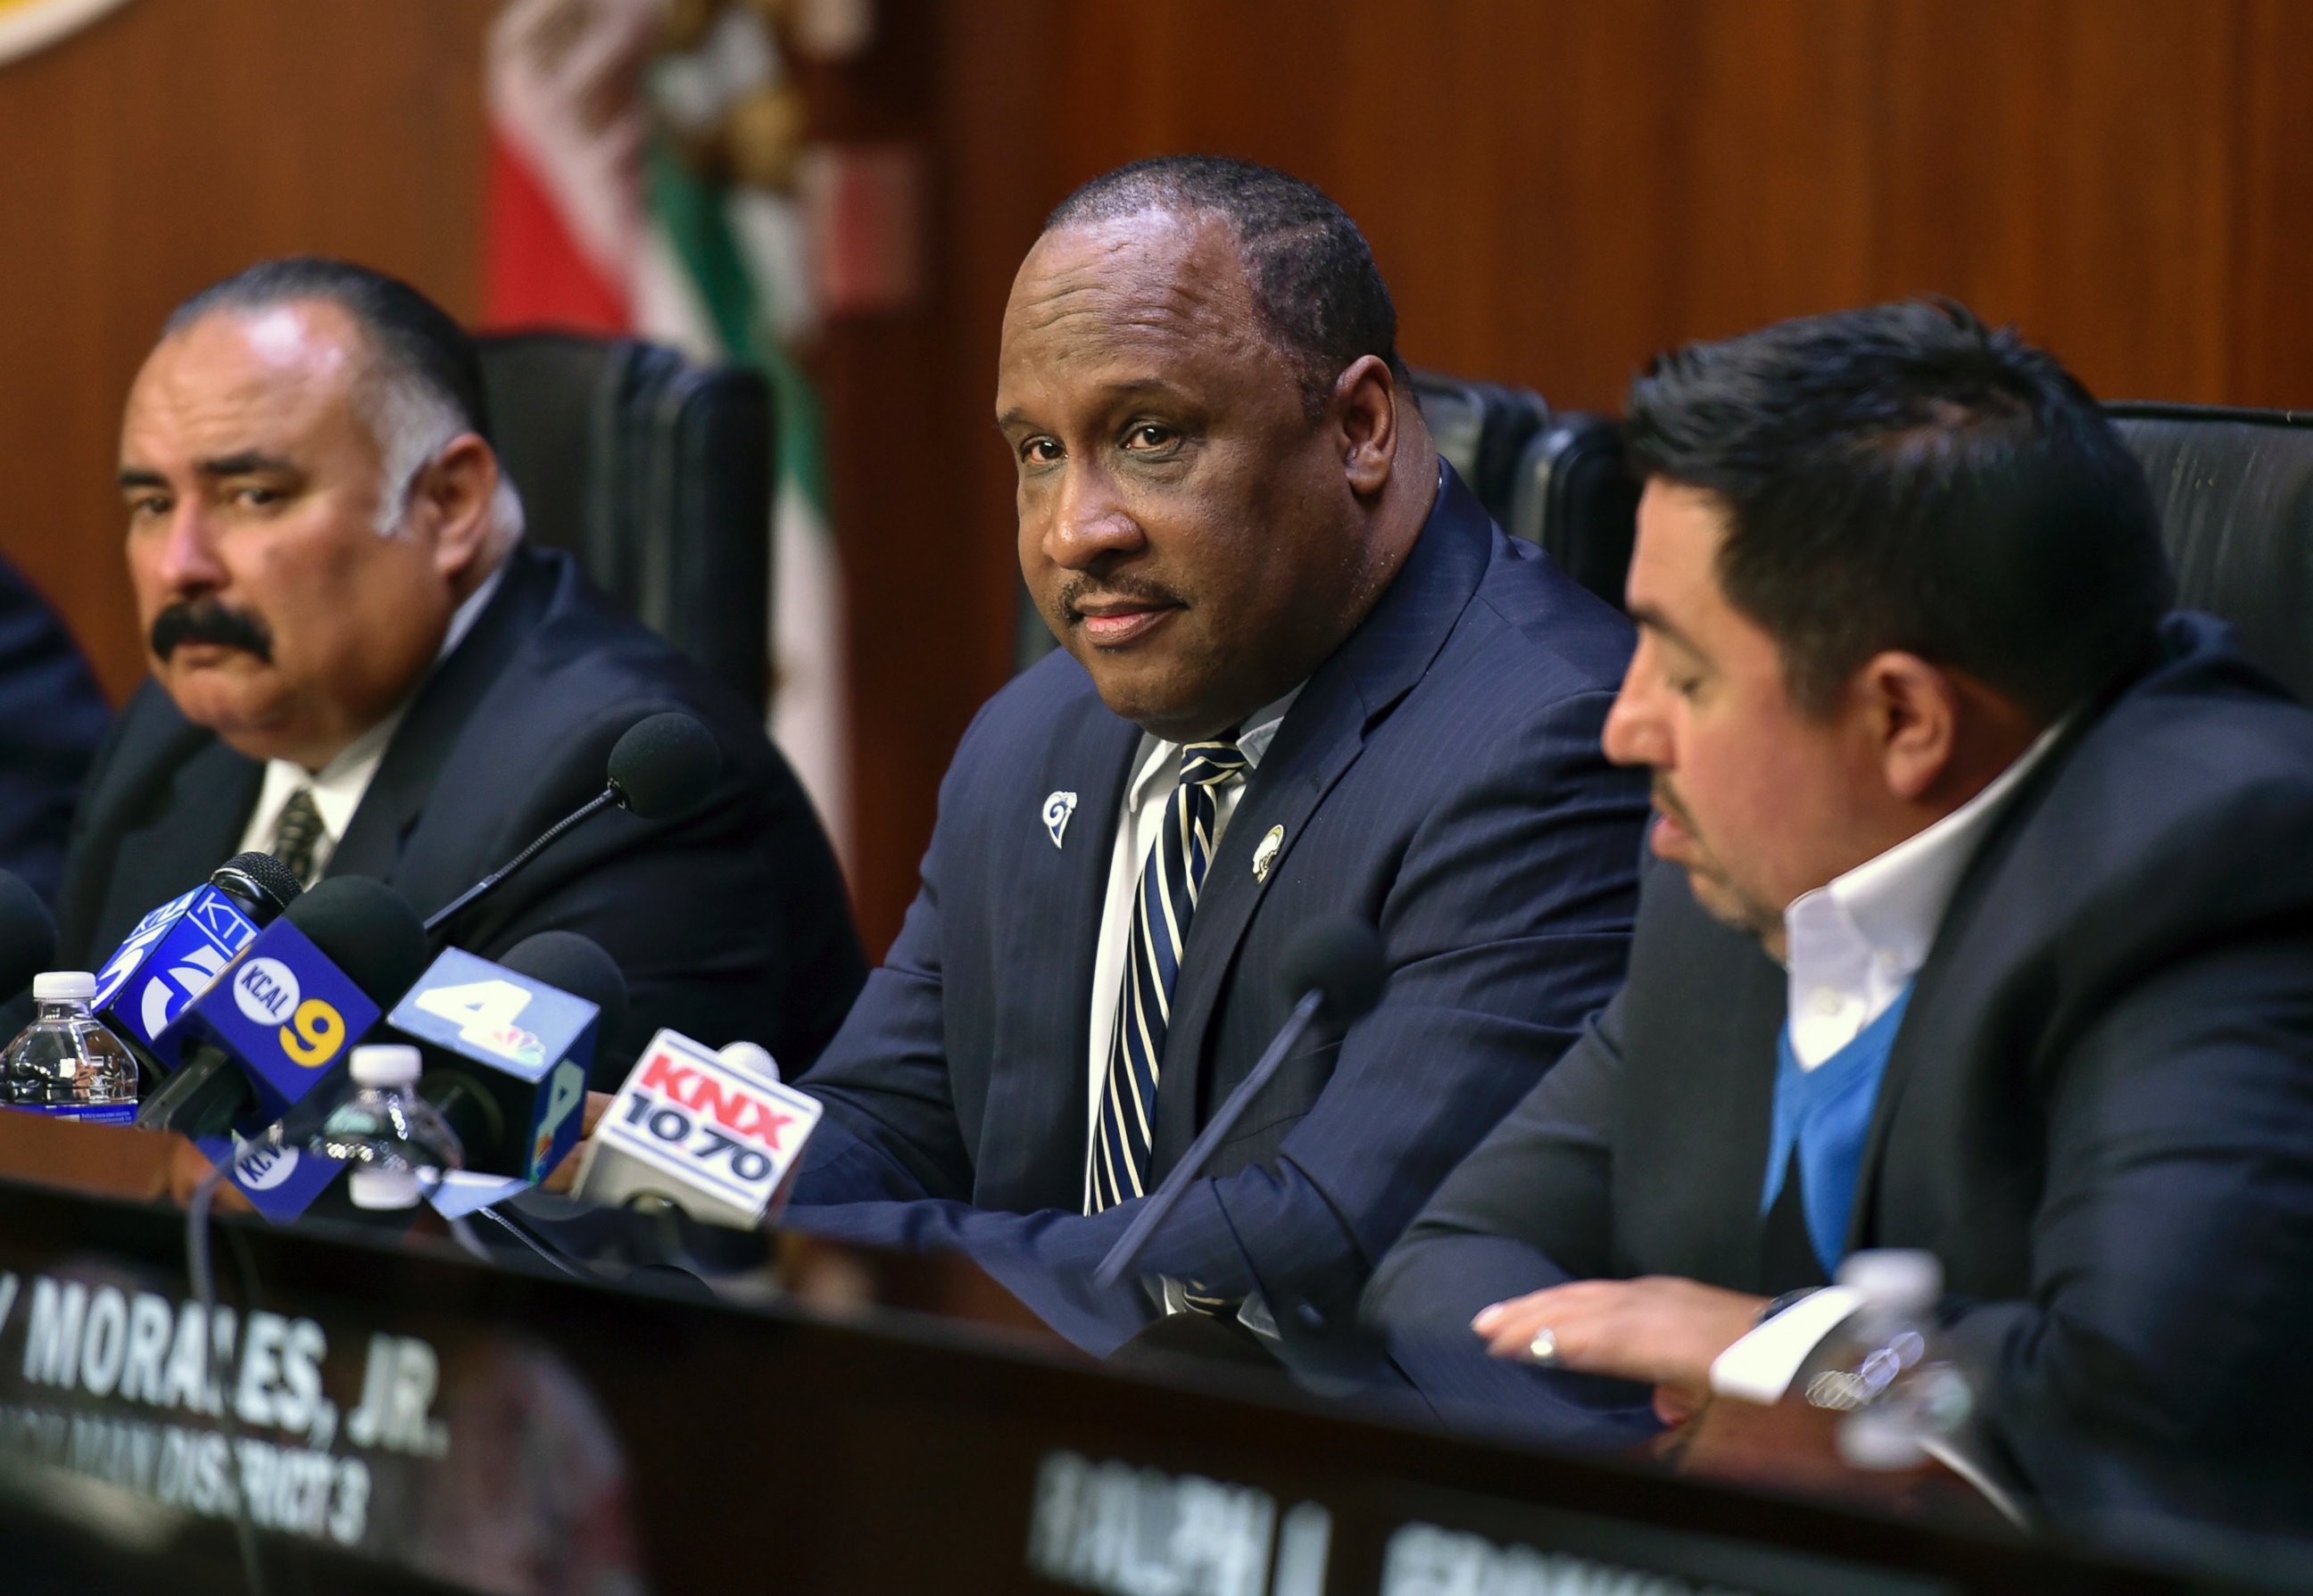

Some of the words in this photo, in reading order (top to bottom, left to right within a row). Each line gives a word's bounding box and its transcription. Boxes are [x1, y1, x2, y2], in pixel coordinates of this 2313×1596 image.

[241, 964, 289, 1018] KCAL
[278, 998, 346, 1068] 9
[414, 980, 533, 1051] 4
[624, 1093, 773, 1181] 1070
[641, 1053, 794, 1152] KNX
[347, 1330, 452, 1460] JR.
[329, 1453, 371, 1547] 3
